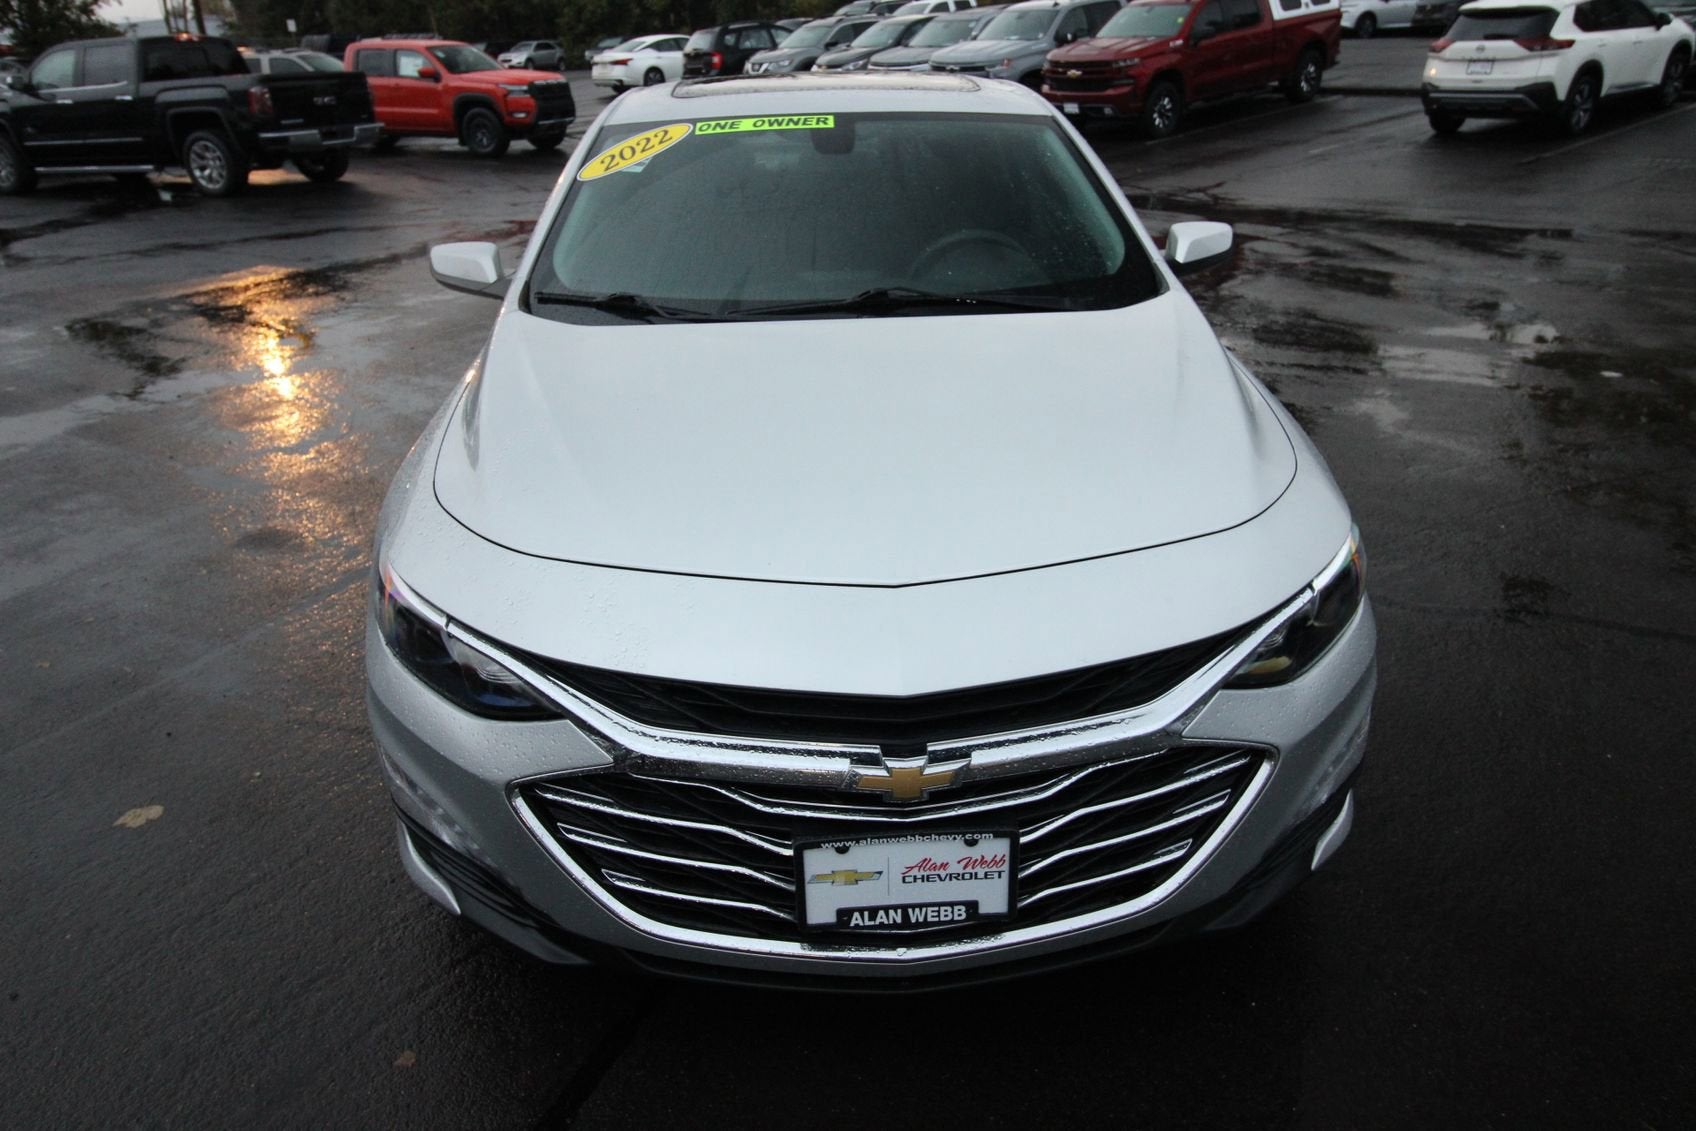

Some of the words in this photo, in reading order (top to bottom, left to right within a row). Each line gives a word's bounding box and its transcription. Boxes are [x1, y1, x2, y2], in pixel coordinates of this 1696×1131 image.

[697, 120, 742, 133] ONE
[753, 116, 829, 127] OWNER
[600, 129, 673, 172] 2022
[821, 832, 994, 849] www.alanwebbchevy.com
[901, 857, 950, 875] Alan
[957, 854, 1006, 870] Webb
[901, 870, 1006, 884] CHEVROLET
[849, 908, 902, 927] ALAN
[908, 905, 966, 922] WEBB
